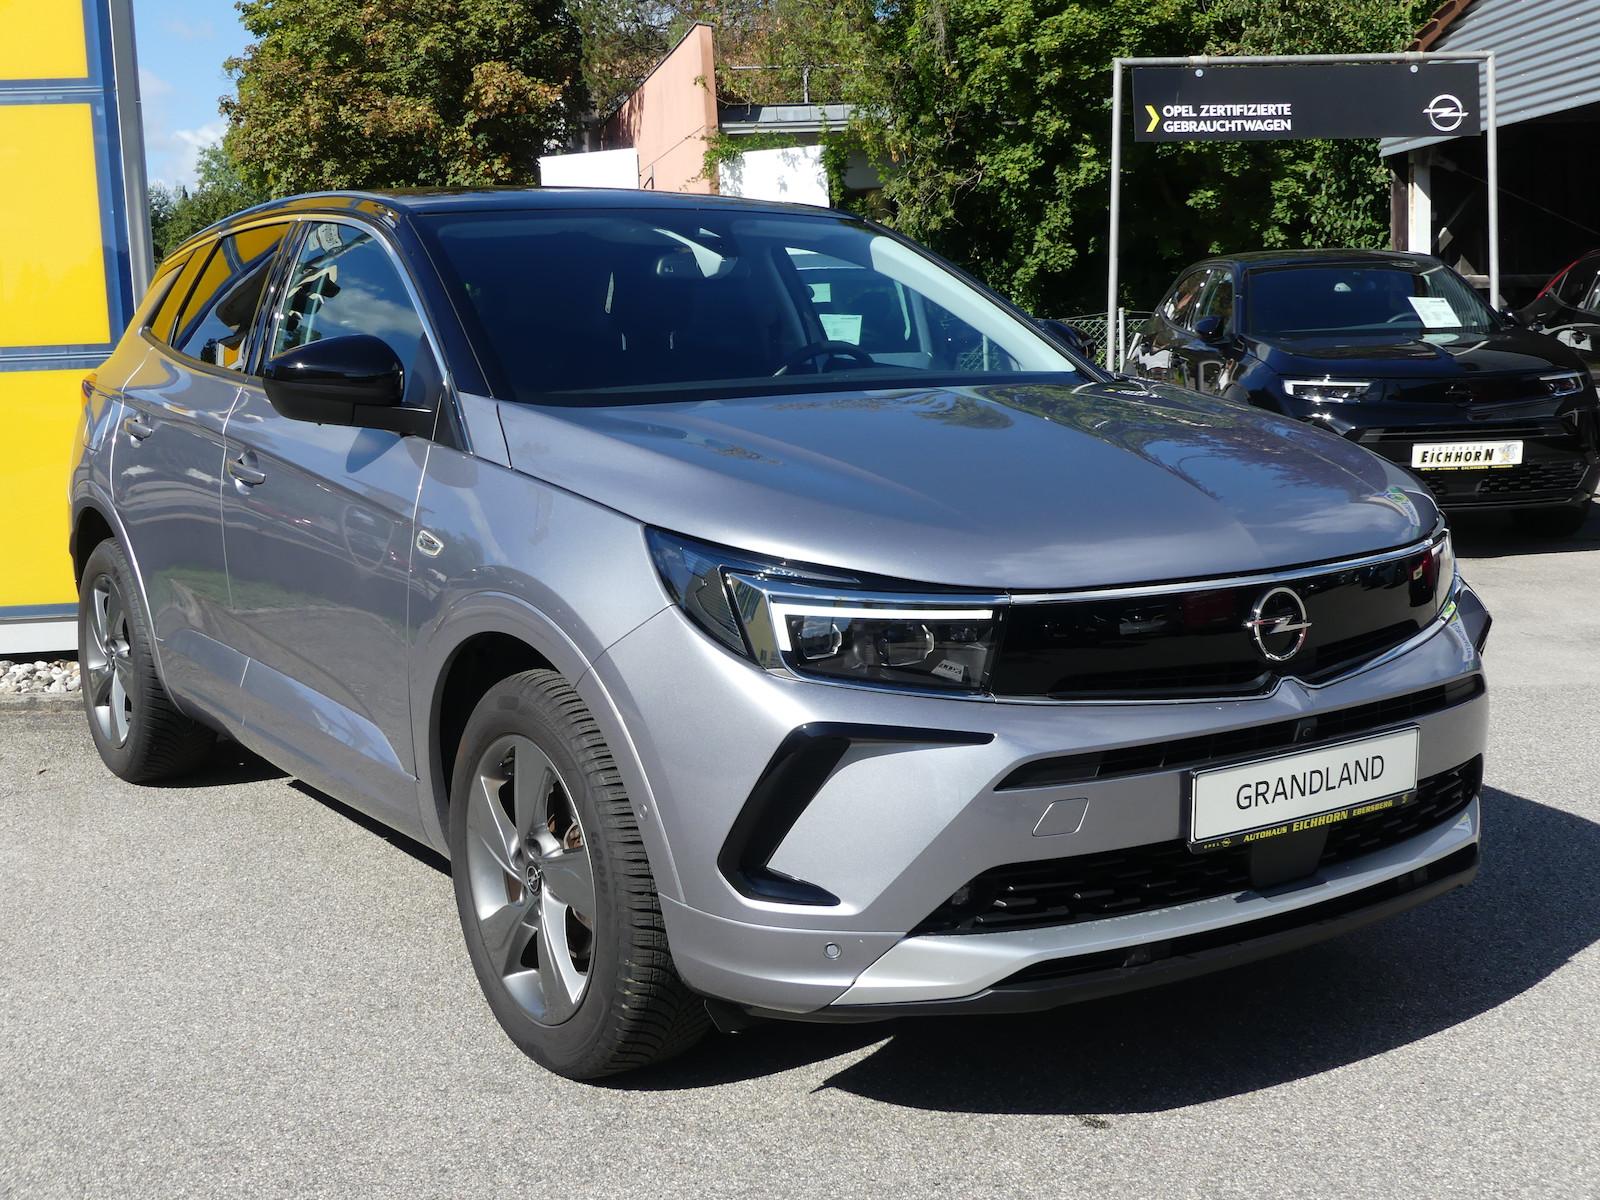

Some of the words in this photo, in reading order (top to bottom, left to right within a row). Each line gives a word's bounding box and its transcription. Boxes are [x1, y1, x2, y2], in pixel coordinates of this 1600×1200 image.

[1163, 105, 1197, 118] OPEL
[1199, 103, 1292, 117] ZERTIFIZIERTE
[1163, 118, 1292, 133] GEBRAUCHTWAGEN
[1421, 448, 1494, 463] EICHHORN
[1236, 755, 1385, 810] GRANDLAND
[1243, 826, 1288, 843] AUTOHAUS
[1292, 809, 1349, 832] EICHHORN
[1352, 799, 1393, 816] EBERSBERG
